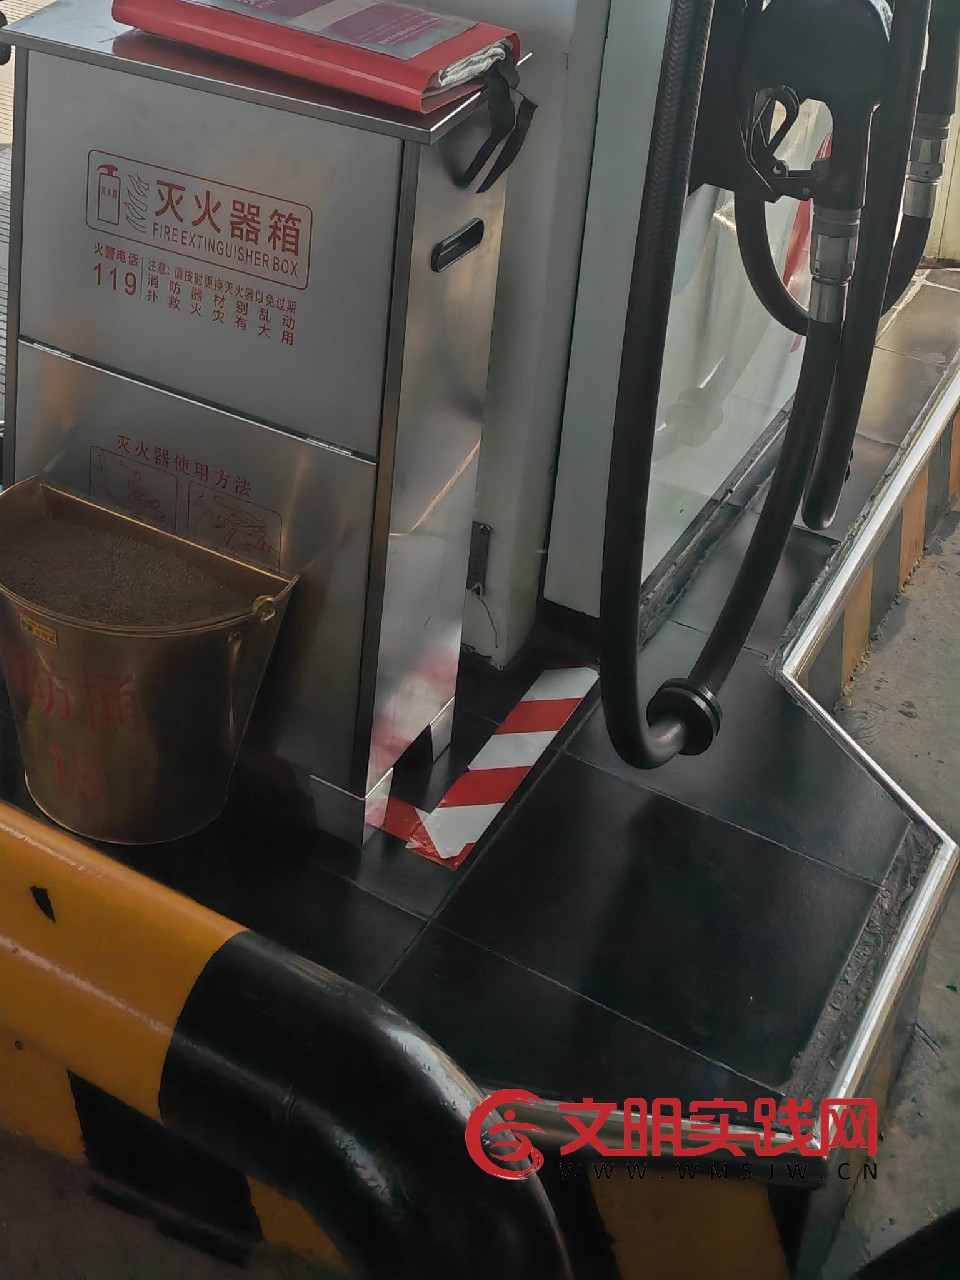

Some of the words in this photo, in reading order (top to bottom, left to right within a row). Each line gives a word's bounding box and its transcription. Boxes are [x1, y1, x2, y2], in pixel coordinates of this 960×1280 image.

[154, 179, 302, 257] 灭火器箱
[93, 242, 139, 267] 火警电话
[152, 221, 179, 244] FIRE
[181, 228, 270, 272] EXTINGUISHER
[272, 256, 299, 278] BOX
[93, 262, 138, 297] 119
[115, 433, 253, 498] 灭火器使用方法
